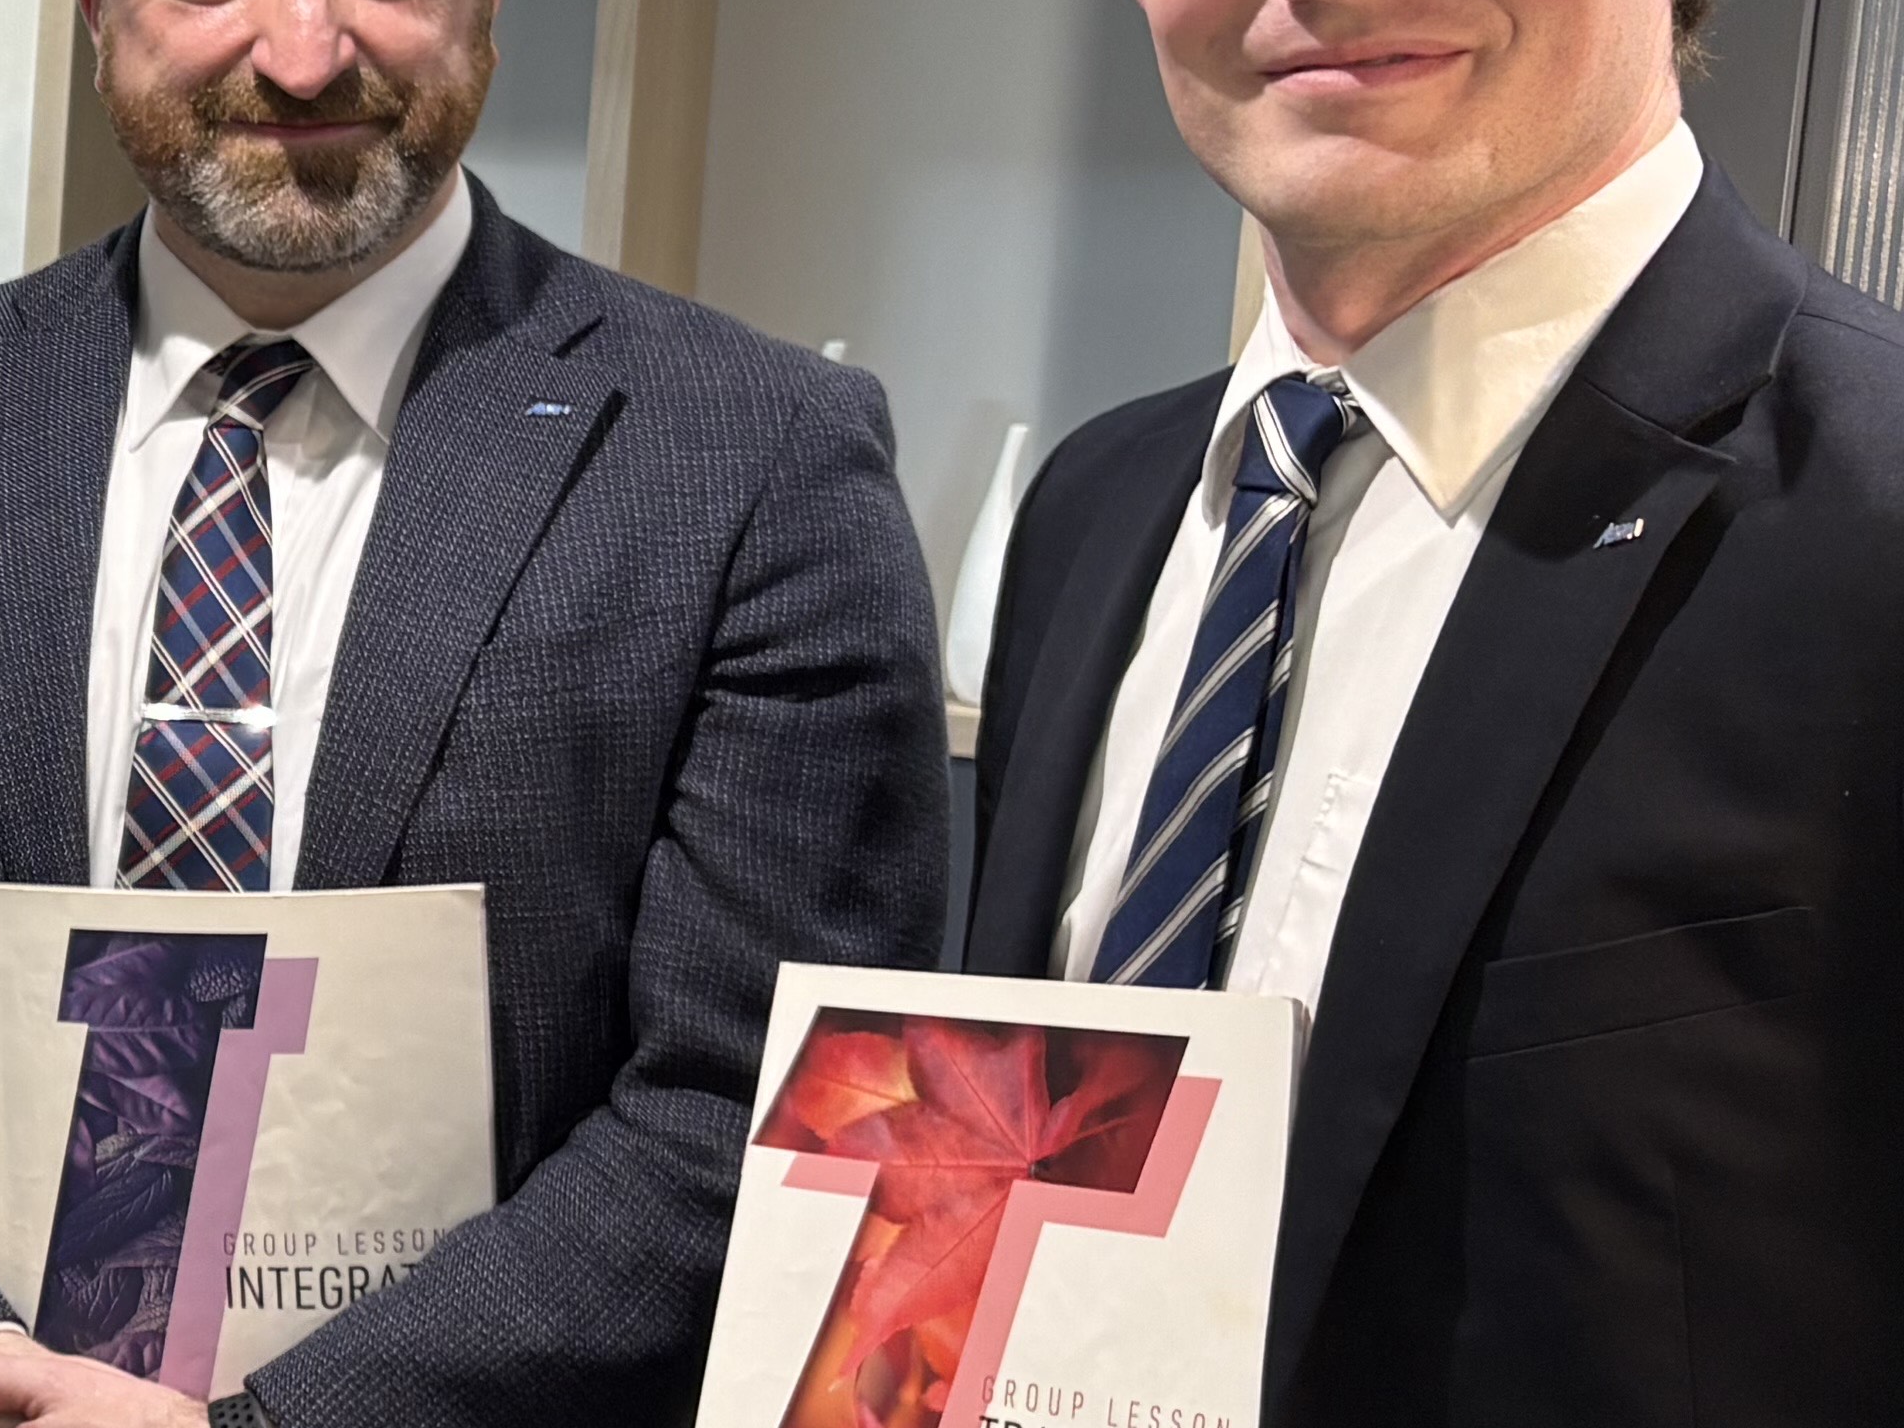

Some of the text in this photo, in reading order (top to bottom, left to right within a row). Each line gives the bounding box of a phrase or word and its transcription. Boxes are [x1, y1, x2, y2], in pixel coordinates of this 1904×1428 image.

[223, 1228, 446, 1257] GROUP LESSON
[982, 1375, 1085, 1420] GROUP
